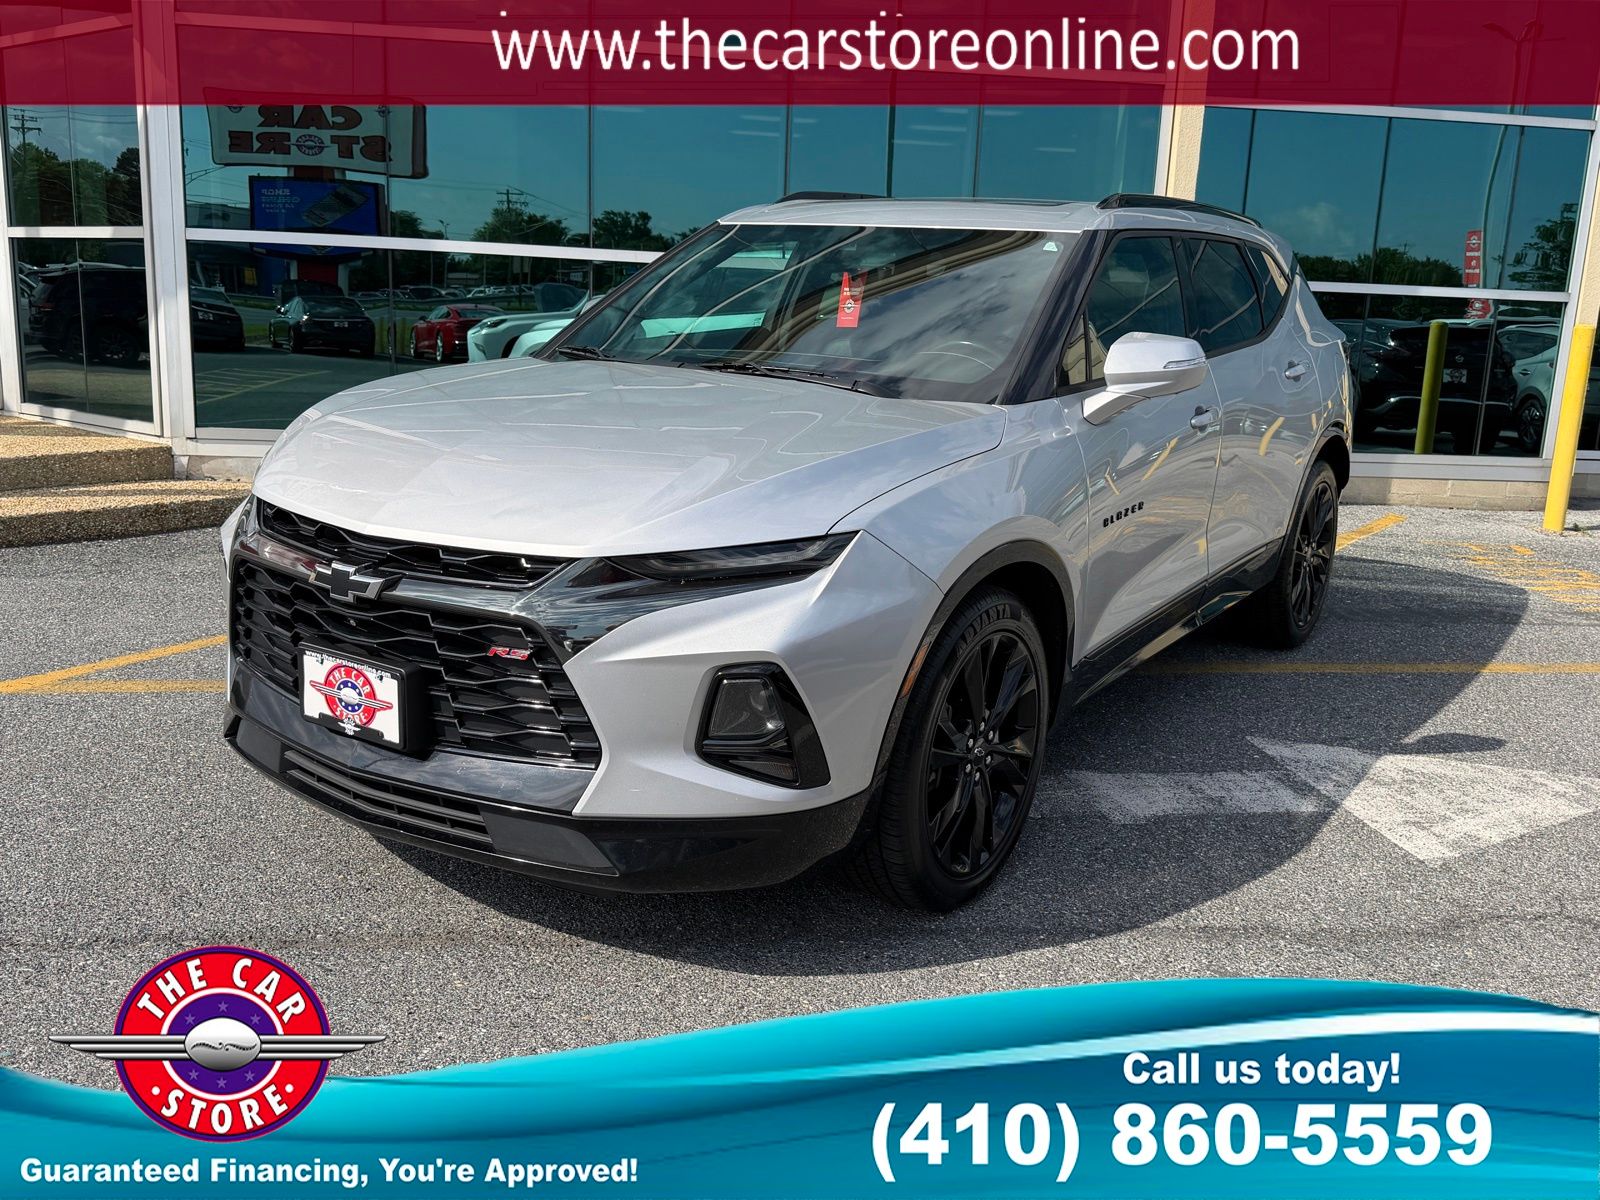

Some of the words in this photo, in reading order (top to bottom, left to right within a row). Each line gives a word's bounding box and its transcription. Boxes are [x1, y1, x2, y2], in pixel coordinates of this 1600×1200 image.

[1103, 501, 1144, 527] BLAZER
[955, 603, 1011, 658] ADVANTA
[488, 646, 530, 660] RS
[329, 667, 347, 684] THE
[351, 671, 370, 693] CAR
